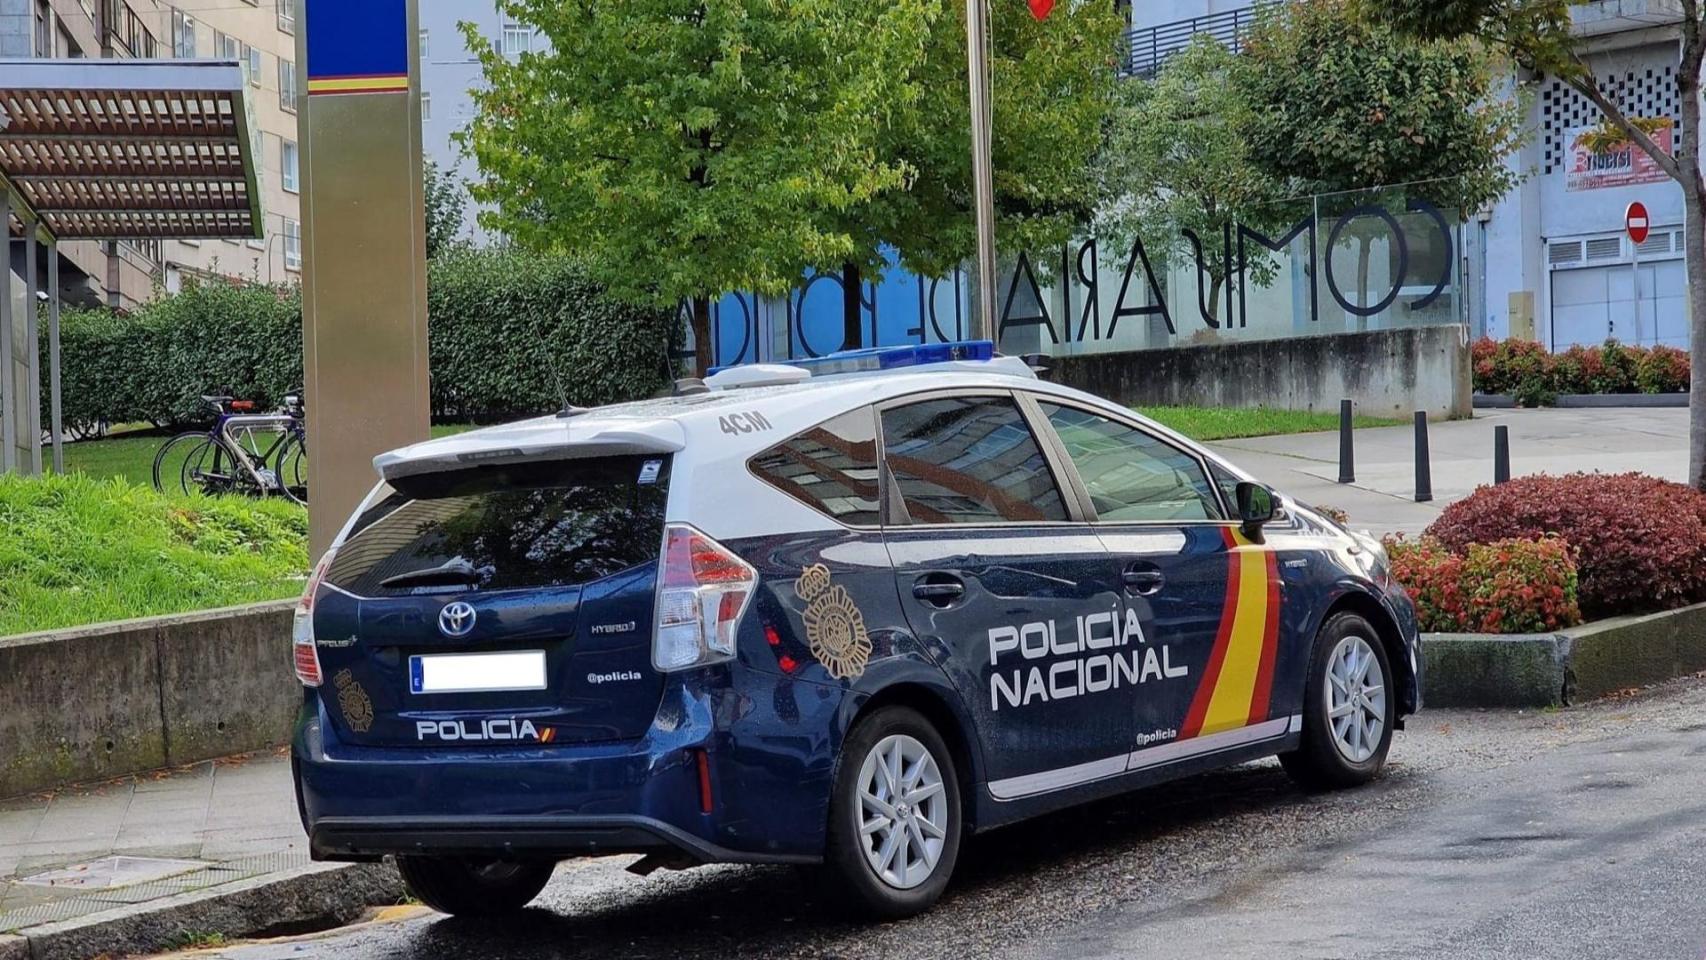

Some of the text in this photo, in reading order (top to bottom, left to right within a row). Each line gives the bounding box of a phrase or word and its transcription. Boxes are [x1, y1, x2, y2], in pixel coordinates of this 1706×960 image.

[718, 410, 773, 436] 4CM
[988, 602, 1146, 666] POLICÍA
[587, 670, 642, 684] @policia
[990, 644, 1189, 712] NACIONAL
[416, 715, 540, 740] POLICÍA
[1136, 728, 1177, 746] @policia
